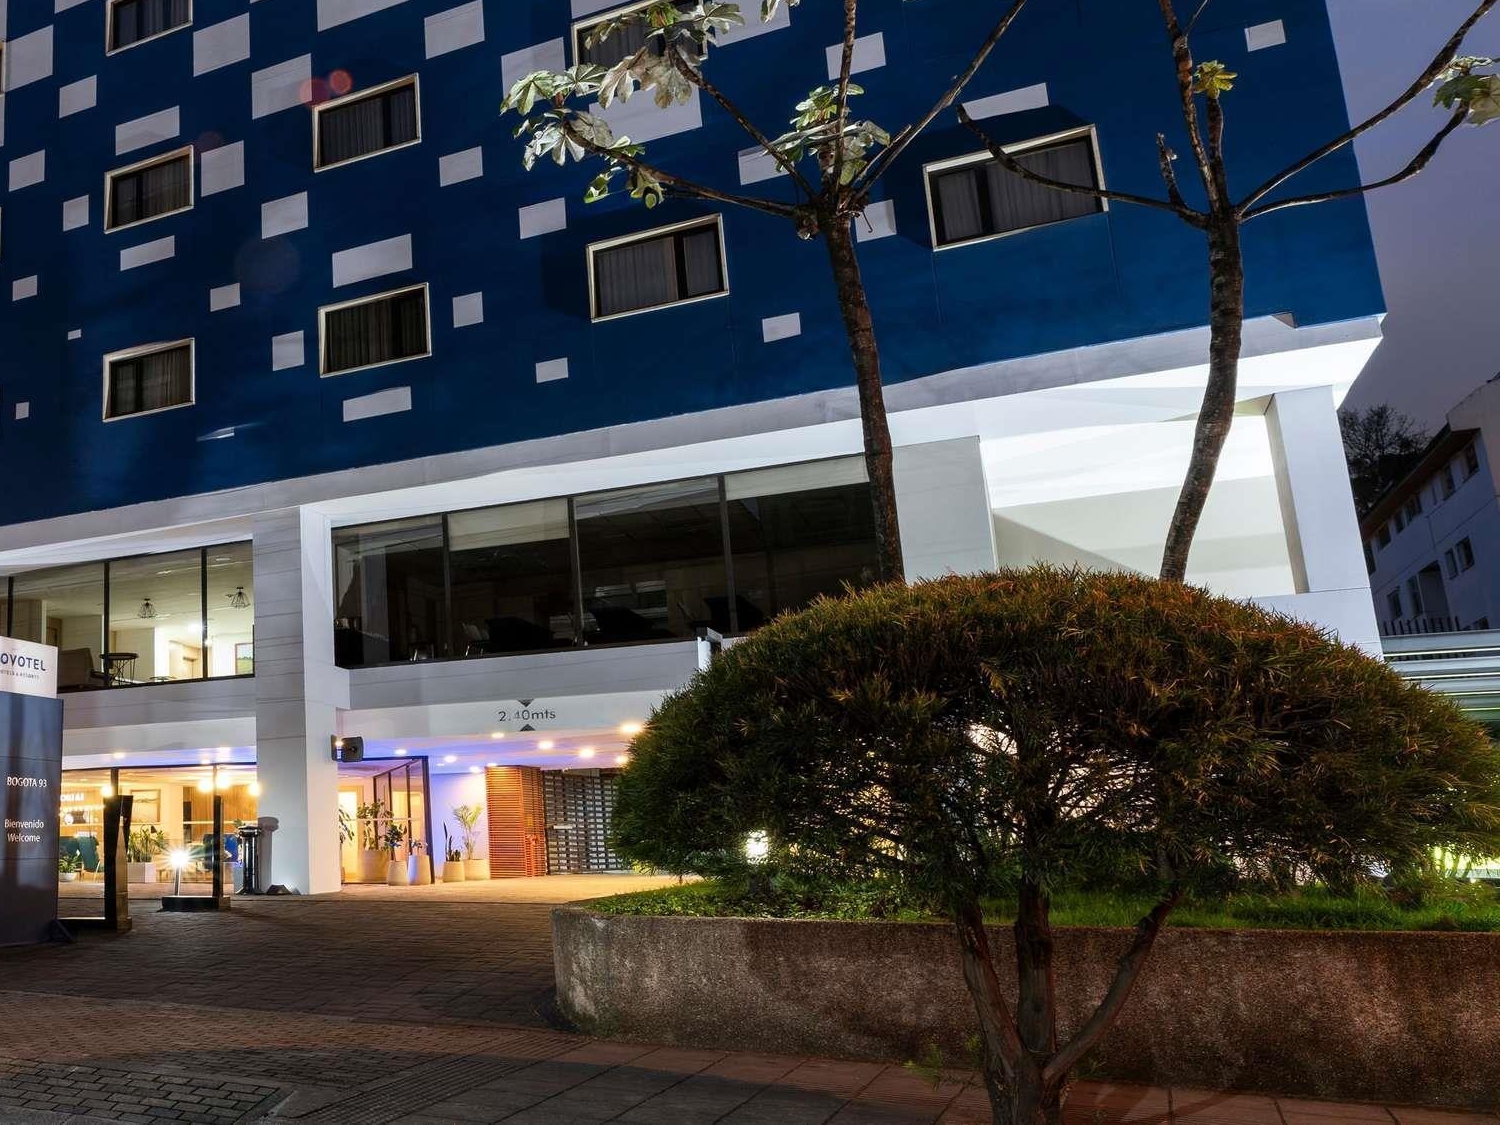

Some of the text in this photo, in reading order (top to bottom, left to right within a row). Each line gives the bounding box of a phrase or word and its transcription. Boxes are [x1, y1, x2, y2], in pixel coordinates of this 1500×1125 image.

[6, 776, 47, 788] BOGOTA 93
[4, 818, 45, 829] Bienvenido
[7, 832, 41, 843] Welcome
